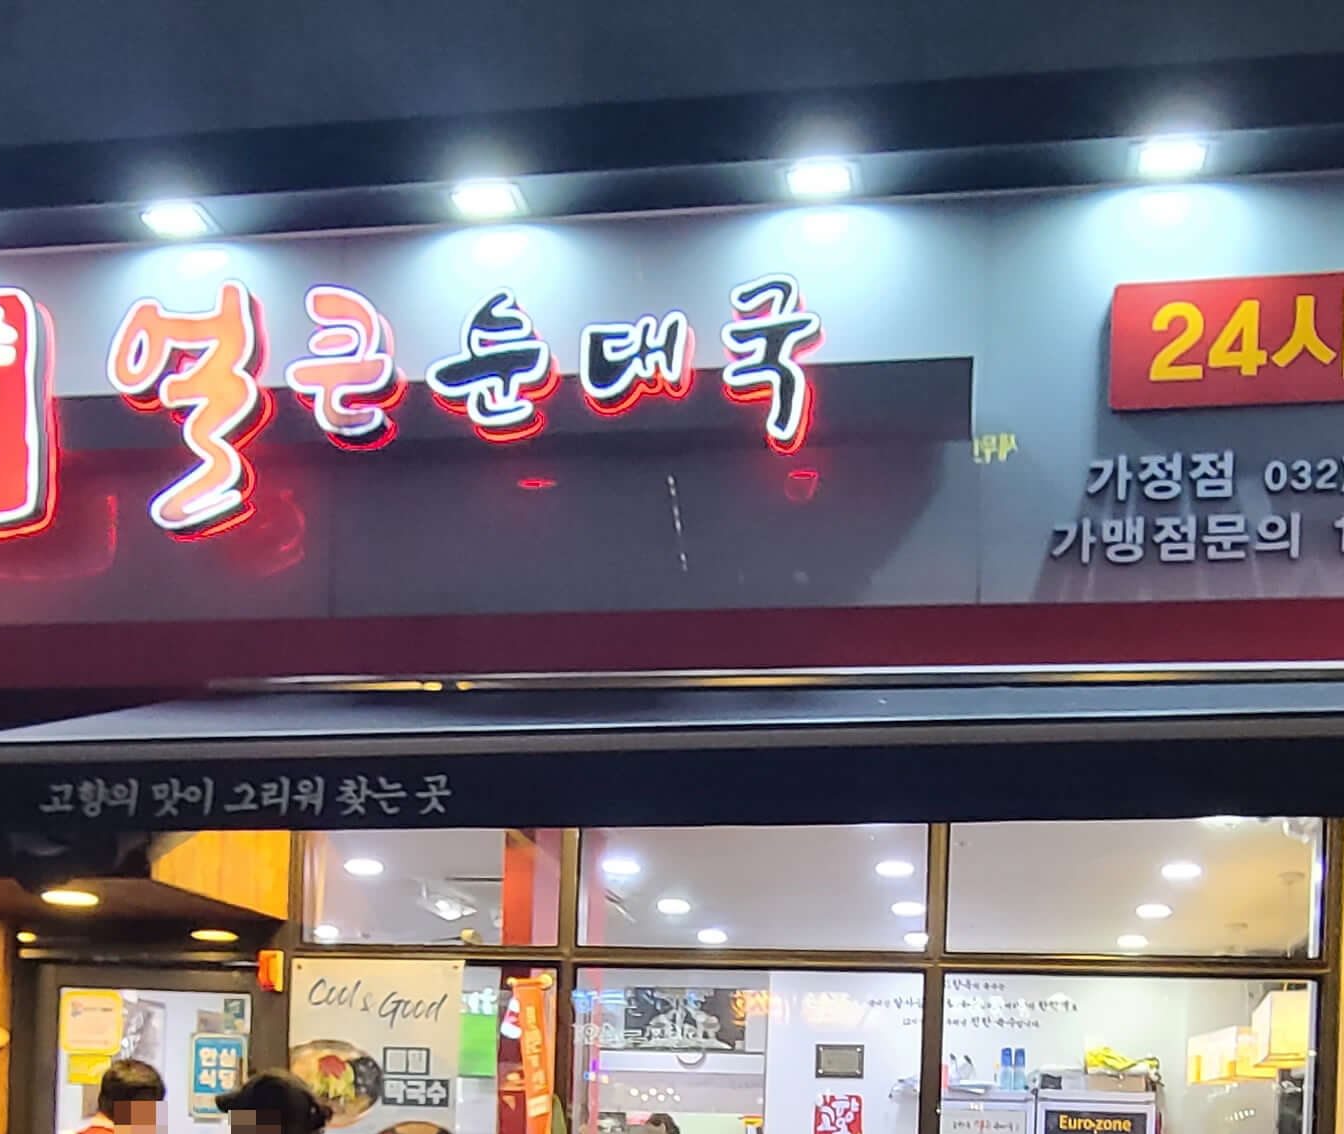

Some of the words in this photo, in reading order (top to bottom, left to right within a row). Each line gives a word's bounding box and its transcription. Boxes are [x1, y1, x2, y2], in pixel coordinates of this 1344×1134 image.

[1086, 450, 1236, 501] 가정점
[1050, 511, 1303, 565] 가맹점문의
[39, 777, 138, 818] 고향의
[151, 776, 213, 816] 맛이
[223, 776, 325, 815] 그리워
[336, 775, 407, 816] 찾는
[415, 774, 453, 815] 곳
[307, 978, 362, 1008] Cool
[378, 991, 449, 1029] Good
